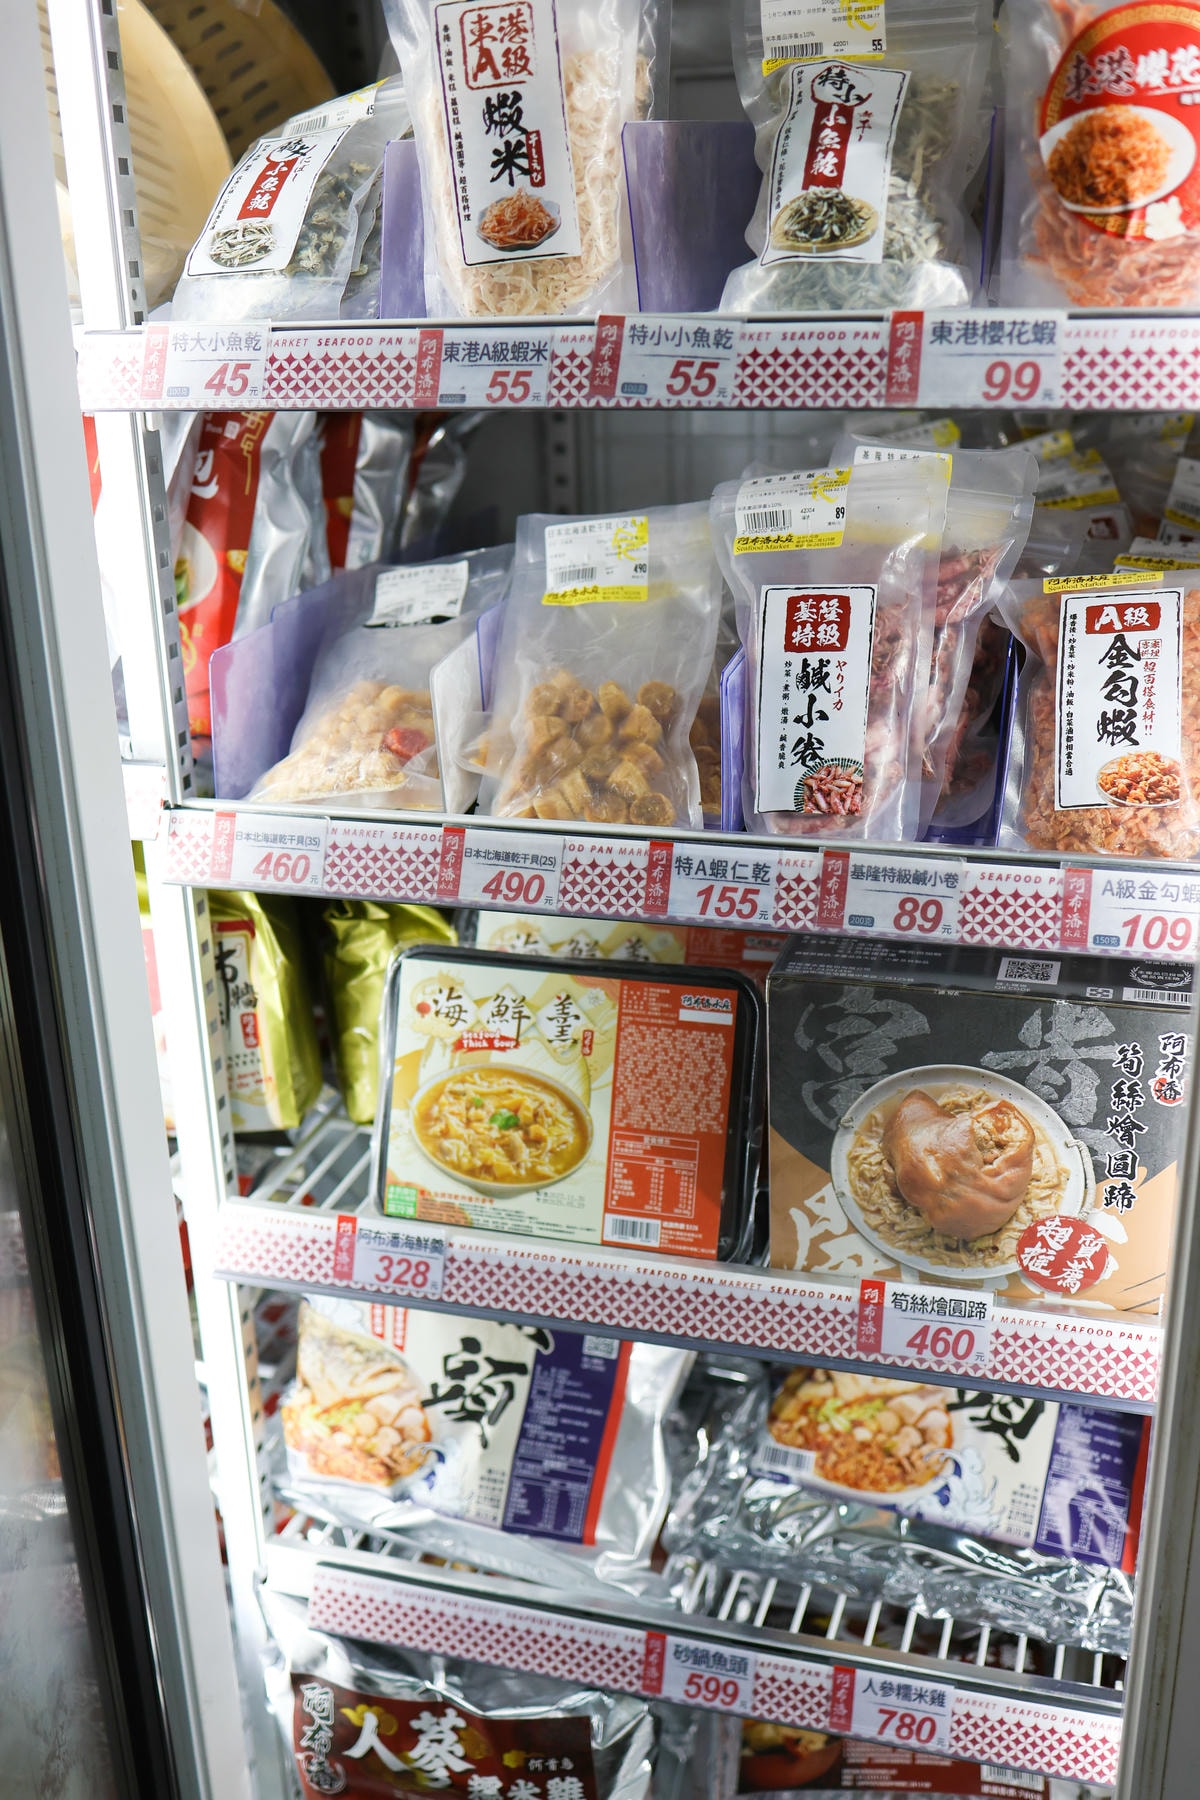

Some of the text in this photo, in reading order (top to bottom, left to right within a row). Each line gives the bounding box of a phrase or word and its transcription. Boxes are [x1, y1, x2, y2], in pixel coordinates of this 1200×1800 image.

[469, 8, 529, 47] 東港
[872, 39, 883, 51] 55
[483, 91, 531, 187] 蝦米
[811, 104, 847, 177] 小魚乾
[248, 161, 290, 212] 小魚乾
[171, 332, 263, 352] 特大小魚乾
[317, 337, 373, 347] SEAFOOD
[379, 336, 403, 346] PAN
[560, 334, 594, 343] MARK
[629, 324, 733, 349] 特小小魚乾
[740, 331, 880, 341] RKET SEAFOOD PAN
[930, 320, 1057, 346] 東港櫻花蝦
[1064, 328, 1118, 338] MARKET
[442, 341, 548, 363] 東港A級蝦米
[205, 362, 251, 397] 45
[486, 370, 533, 404] 55
[666, 359, 720, 397] 55
[982, 361, 1041, 402] 99
[249, 387, 258, 396] 元
[532, 391, 542, 402] 元
[716, 387, 728, 398] 元
[835, 506, 845, 519] 89
[736, 543, 765, 552] Seafood
[765, 542, 790, 551] Market
[1048, 580, 1108, 592] Seafood Market
[793, 598, 843, 623] 基隆
[1094, 606, 1151, 632] A級
[791, 623, 841, 648] 特級
[1096, 633, 1142, 748] 金勾蝦
[790, 657, 832, 769] 鹹小卷
[343, 829, 385, 839] MARKET
[464, 848, 557, 868] 日本北海道乾干貝(2S)
[590, 845, 650, 857] PAN MARK
[777, 858, 815, 868] ARKET
[253, 851, 311, 884] 460
[310, 875, 319, 885] 元
[675, 856, 771, 883] 特A蝦仁乾
[850, 864, 960, 889] 基隆特級鹹小卷
[980, 871, 1064, 887] SEAFOOD PA
[482, 870, 546, 905] 490
[543, 895, 554, 906] 元
[696, 884, 761, 920] 155
[758, 910, 769, 921] 元
[893, 896, 944, 935] 89
[941, 924, 953, 936] 元
[1122, 913, 1193, 952] 109
[462, 1030, 500, 1039] Seafood
[1155, 1033, 1187, 1102] 阿布潘
[1104, 1043, 1148, 1214] 筍絲燴圓蹄
[374, 1255, 430, 1288] 328
[505, 1249, 557, 1262] SEAFOOD
[561, 1256, 582, 1265] PAN
[586, 1261, 628, 1272] MARKET
[636, 1266, 687, 1281] SEAFOOD
[692, 1275, 714, 1284] PAN
[719, 1279, 763, 1291] MARKET
[769, 1285, 824, 1299] SEAFOOD
[829, 1292, 852, 1303] PAN
[891, 1291, 988, 1320] 筍絲燴圓蹄
[1001, 1315, 1144, 1342] MARKET SEAFOOD PAN
[906, 1323, 976, 1362] 460
[974, 1350, 985, 1362] 元
[673, 1643, 749, 1676] 砂鍋魚頭
[759, 1661, 821, 1678] AFOOD PAN
[684, 1672, 740, 1707] 599
[862, 1677, 947, 1708] 人參糯米雞
[877, 1707, 937, 1746] 780
[955, 1697, 1122, 1732] MARKET SEAFOOD PAN MARK
